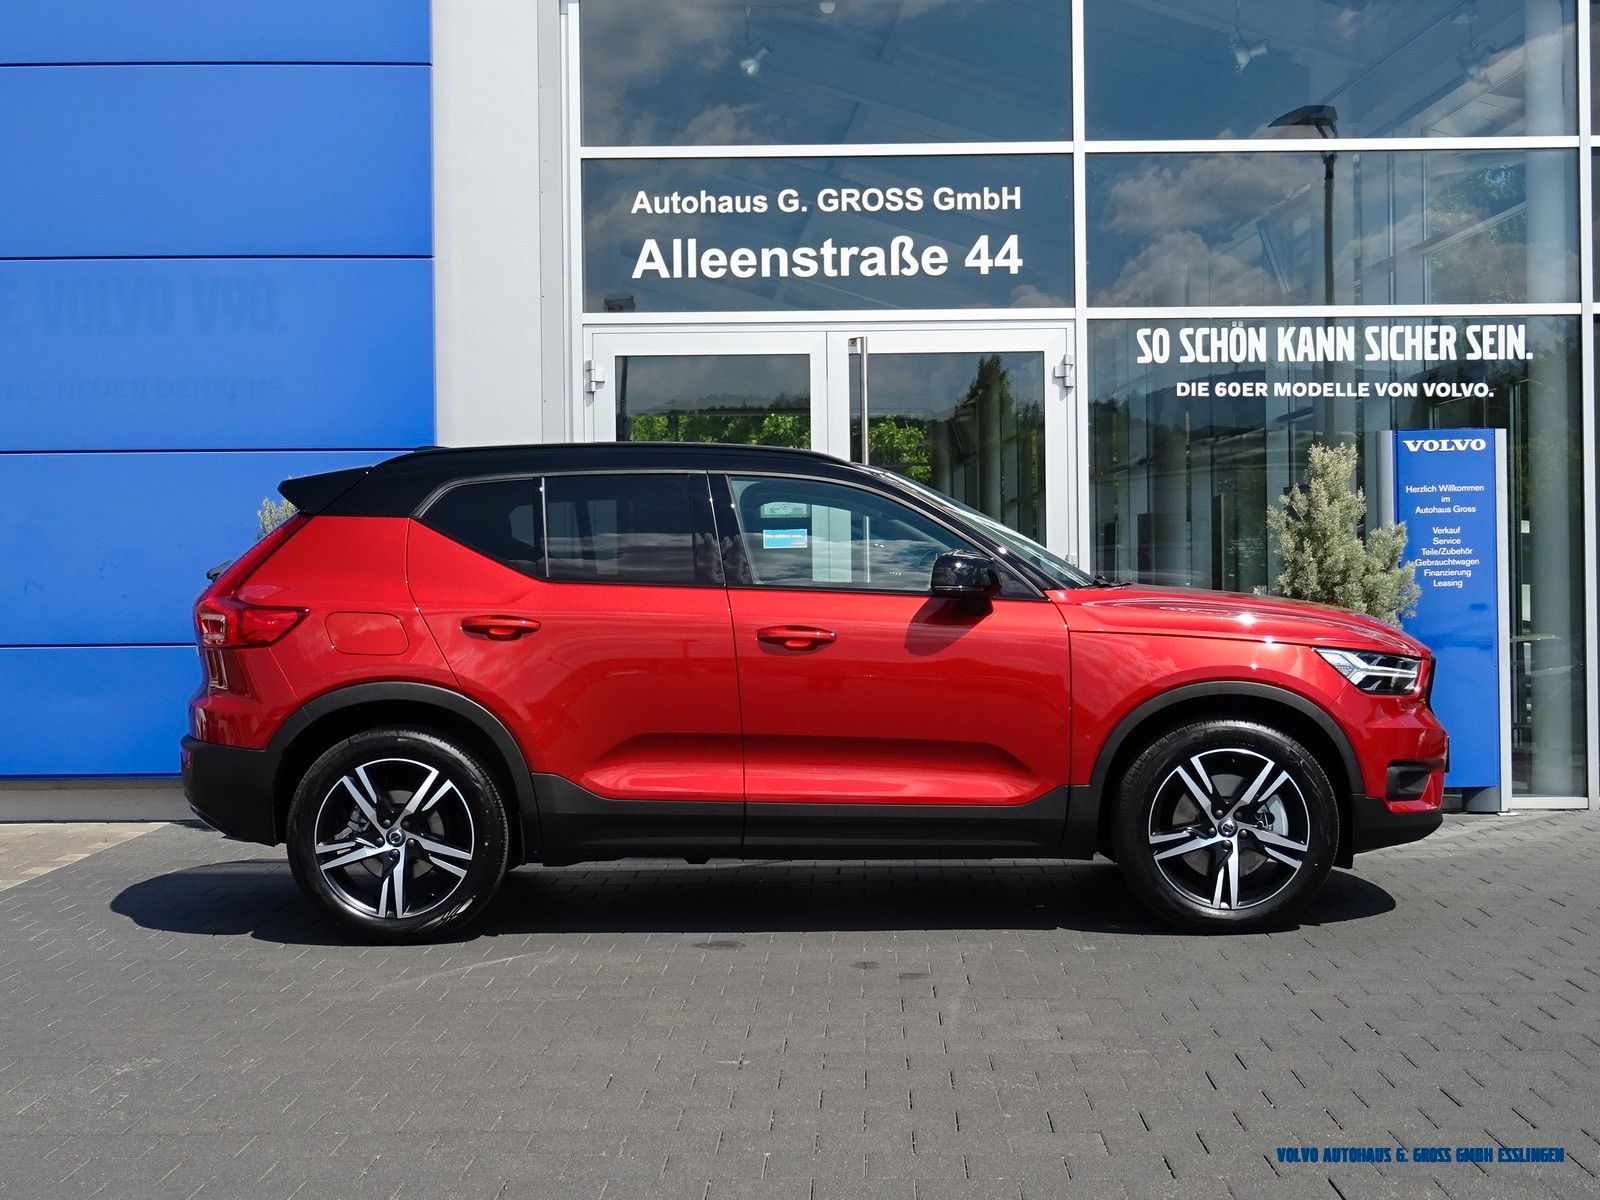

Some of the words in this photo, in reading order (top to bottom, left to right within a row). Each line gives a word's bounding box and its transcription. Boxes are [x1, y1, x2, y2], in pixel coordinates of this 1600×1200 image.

[631, 189, 768, 214] Autohaus
[778, 189, 808, 213] G.
[817, 187, 924, 213] GROSS
[933, 186, 1021, 211] GmbH
[631, 235, 949, 279] Alleenstraße
[964, 234, 1024, 275] 44
[1136, 327, 1170, 364] SO
[1179, 321, 1267, 364] SCHÖN
[1277, 325, 1355, 363] KANN
[1364, 324, 1458, 362] SICHER
[1465, 324, 1534, 361] SEIN.
[1176, 382, 1210, 397] DIE
[1214, 381, 1269, 398] 60ER
[1273, 382, 1370, 398] MODELLE
[1375, 382, 1418, 398] VON
[1422, 382, 1494, 398] VOLVO.
[1403, 438, 1487, 452] VOLVO
[1405, 485, 1437, 493] Herzlich
[1438, 484, 1485, 493] Willkommen
[1440, 495, 1451, 503] im
[1415, 505, 1451, 514] Autohaus
[1453, 504, 1477, 513] Gross
[1432, 526, 1461, 535] Verkauf
[1432, 537, 1462, 545] Service
[1421, 547, 1473, 556] Teile/Zubehör
[1414, 558, 1480, 568] Gebrauchtwagen
[1423, 568, 1472, 578] Finanzierung
[1433, 579, 1463, 589] Leasing
